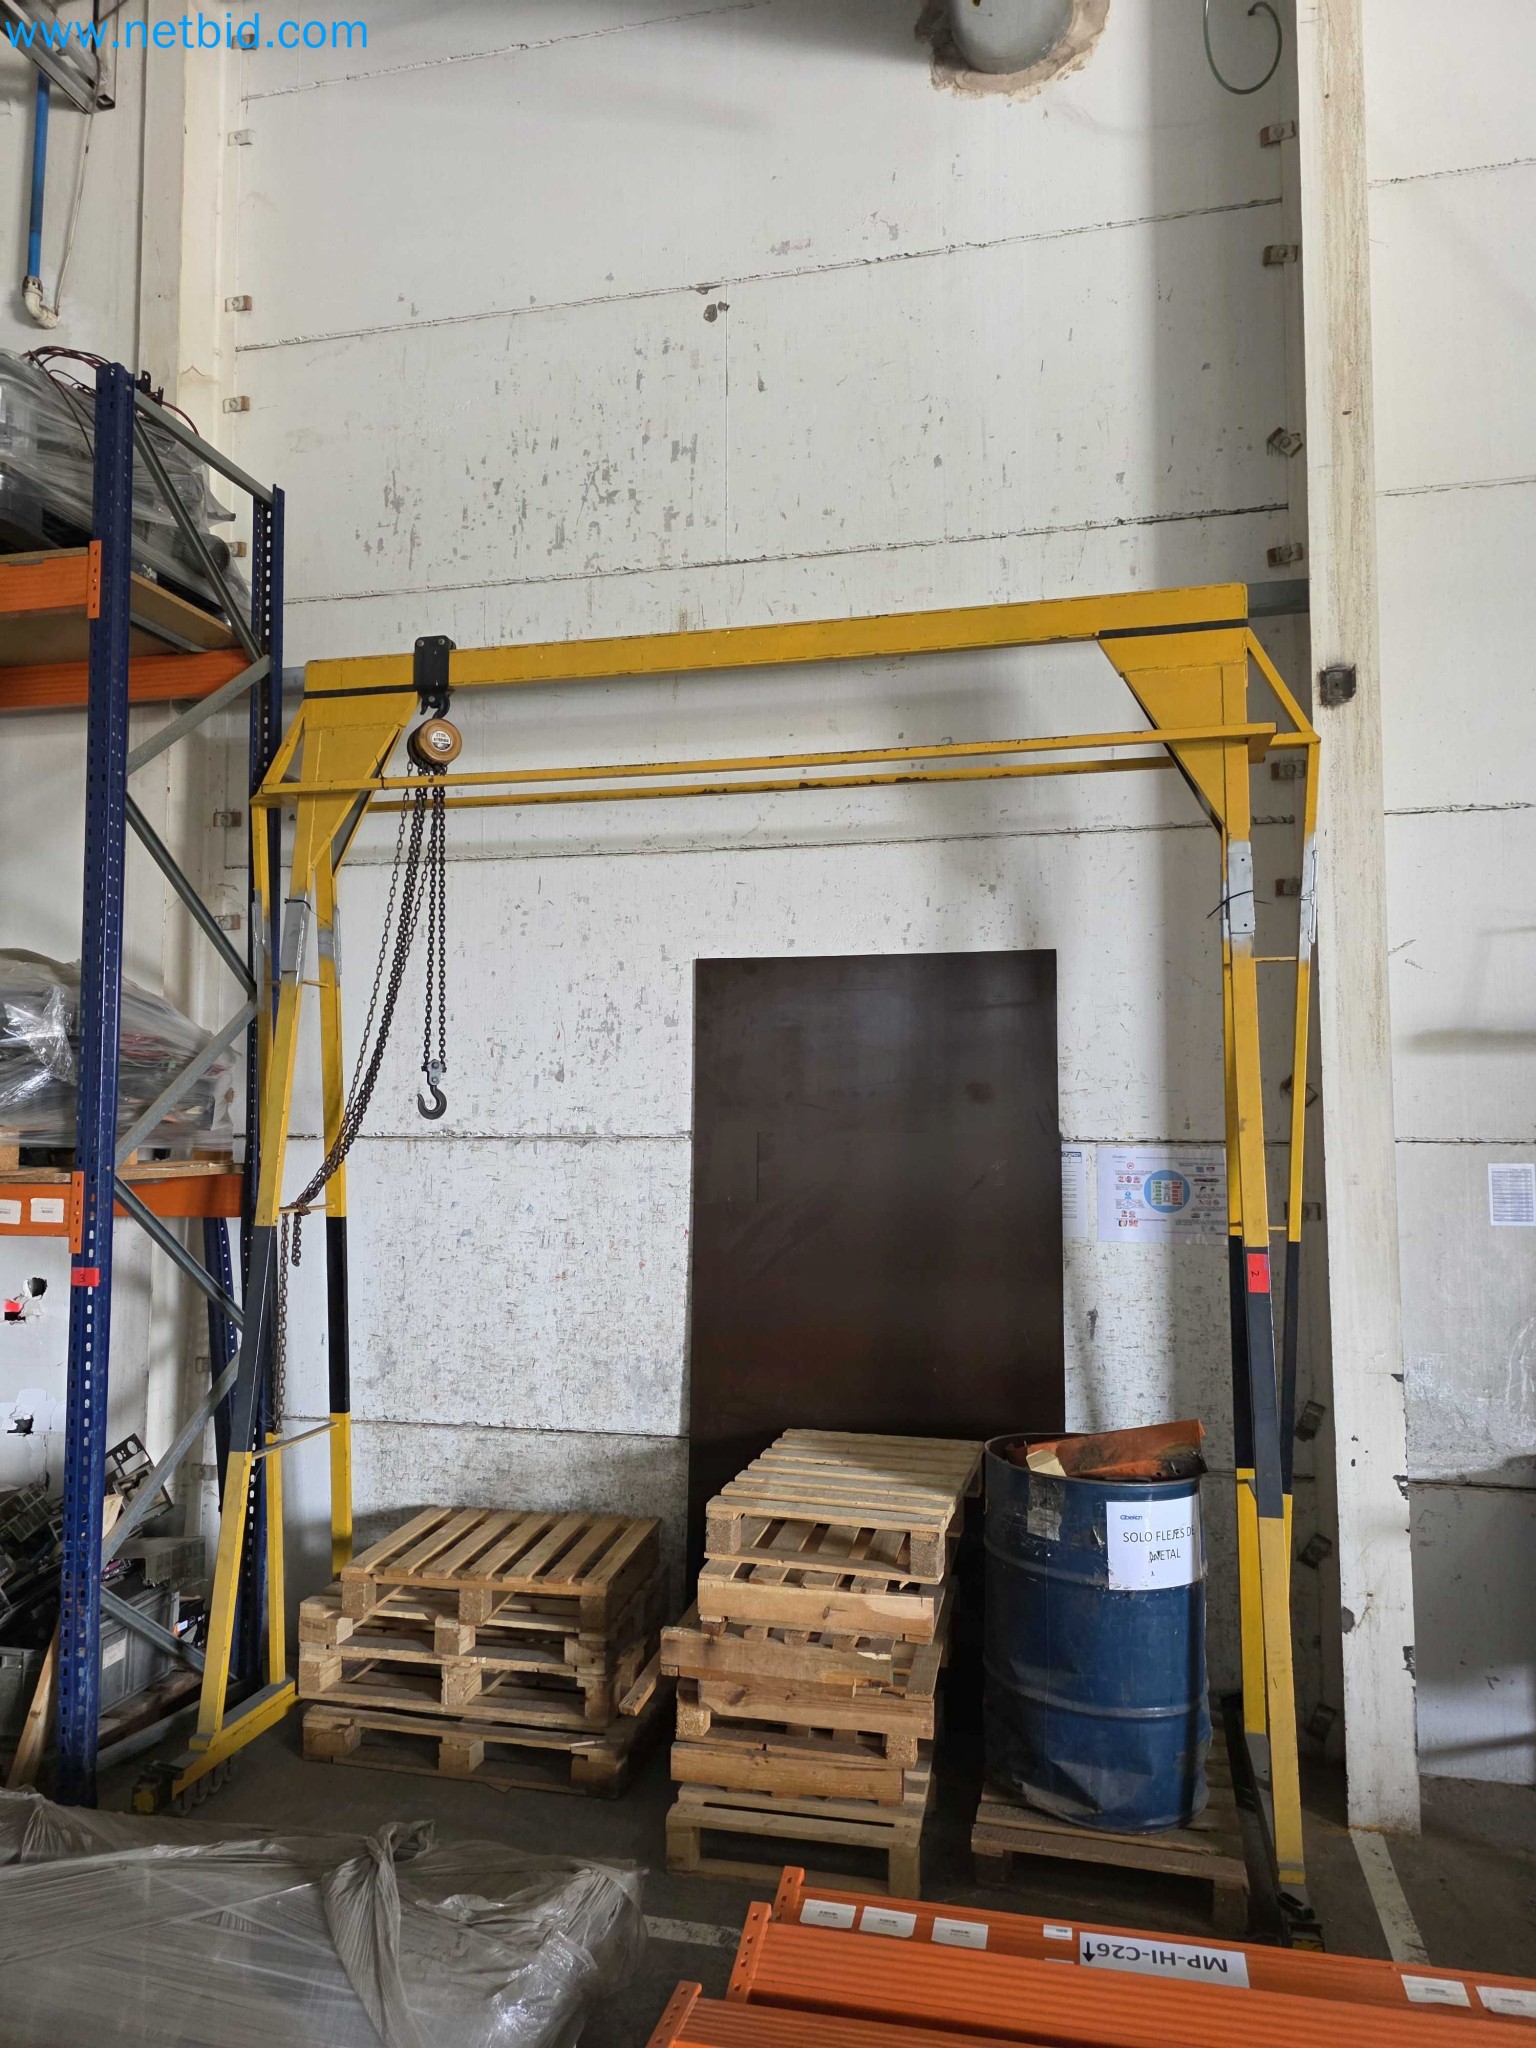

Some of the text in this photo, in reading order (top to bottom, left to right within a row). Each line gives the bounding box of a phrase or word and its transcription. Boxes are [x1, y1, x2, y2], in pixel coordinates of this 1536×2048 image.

[1123, 1532, 1152, 1542] SOLO
[1156, 1528, 1184, 1541] FLEJES
[1096, 1943, 1227, 1973] MP-HI-C26
